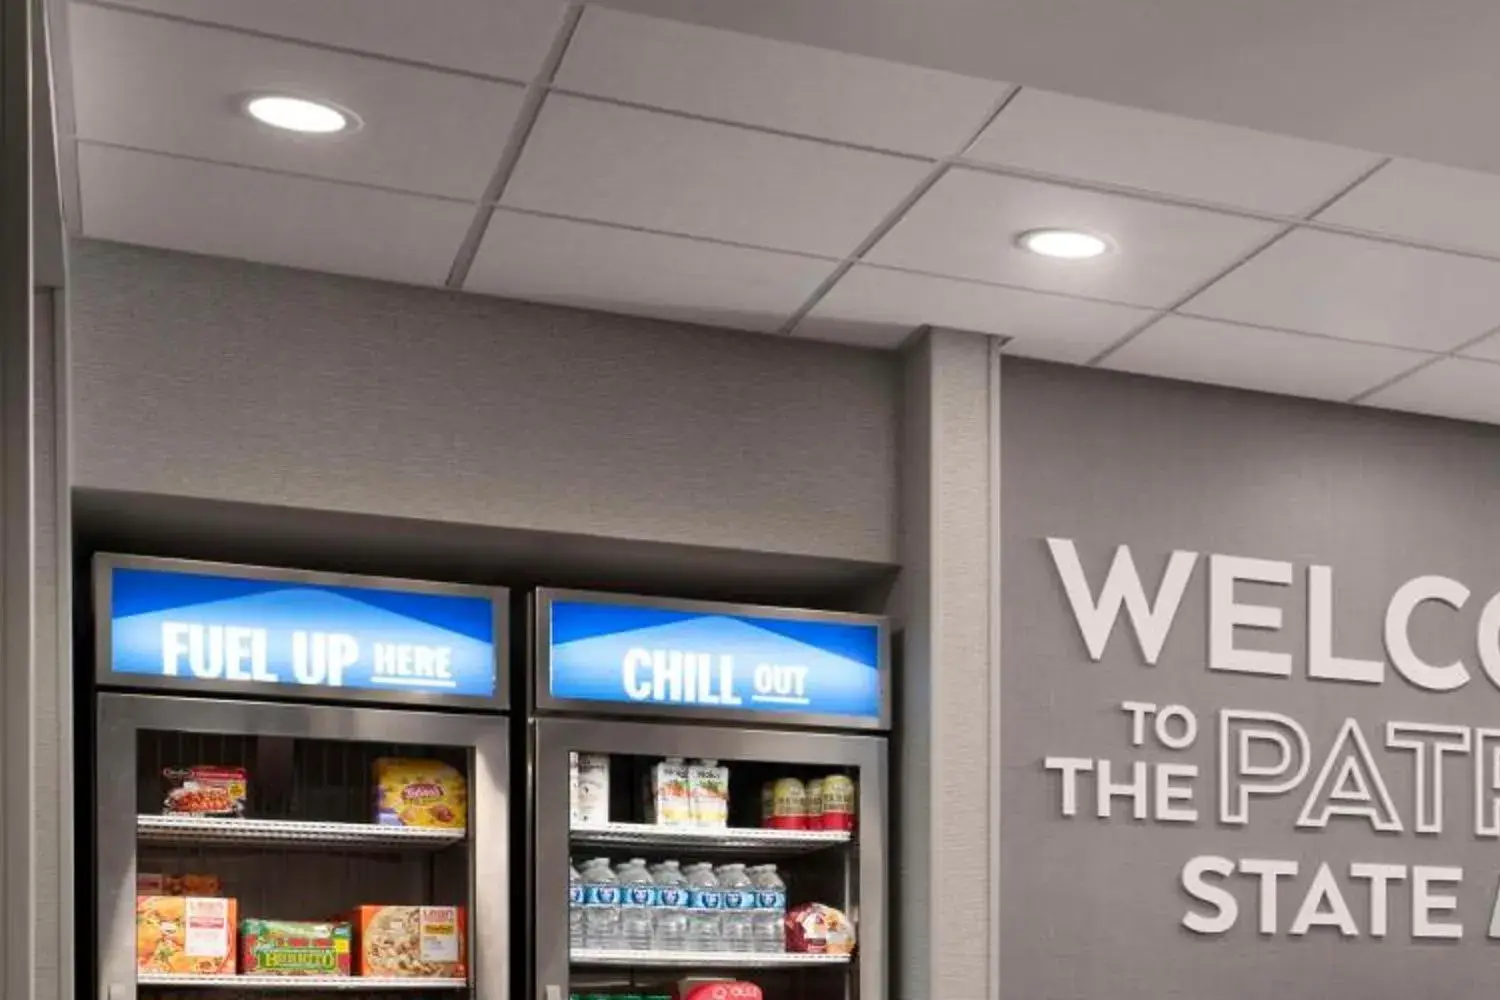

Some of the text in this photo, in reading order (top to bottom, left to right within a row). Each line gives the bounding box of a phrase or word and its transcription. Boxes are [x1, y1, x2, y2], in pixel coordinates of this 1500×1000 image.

[161, 621, 453, 688] FUEL UP HERE
[622, 648, 810, 706] CHILL OUT
[1121, 701, 1198, 750] TO
[1044, 756, 1199, 823] THE
[1181, 855, 1464, 940] STATE
